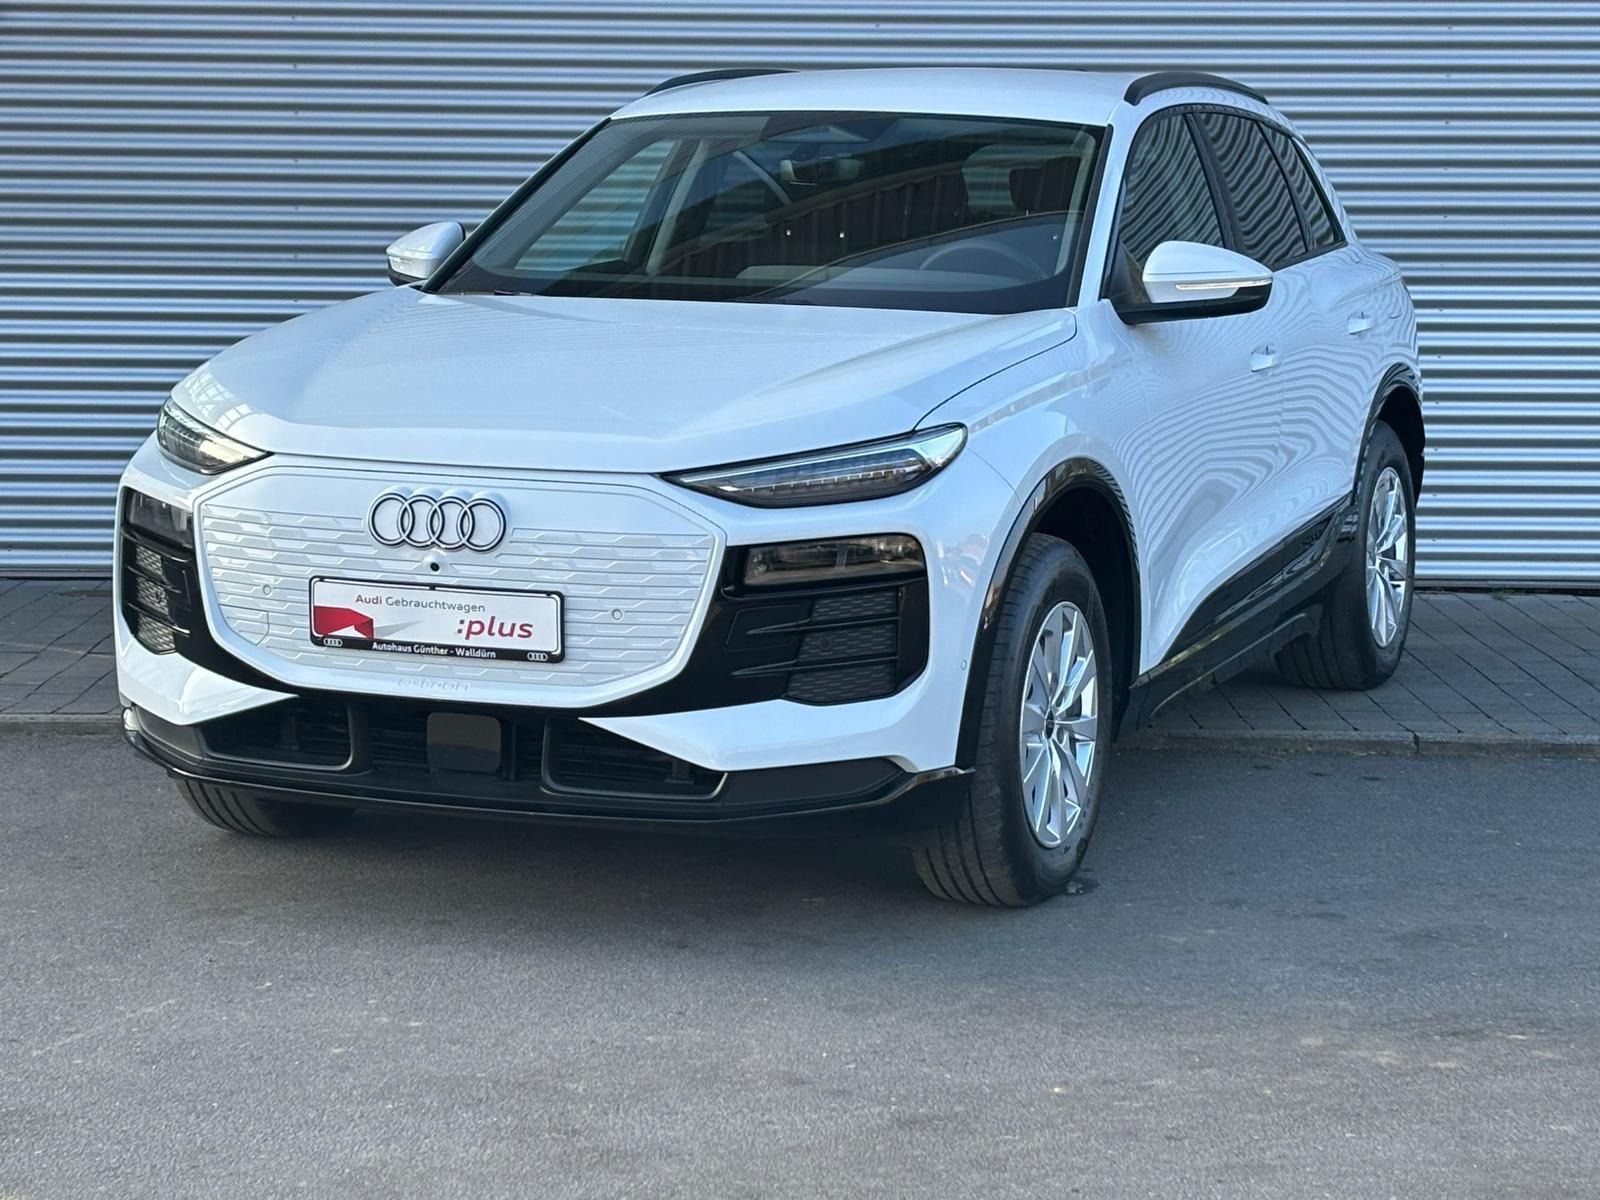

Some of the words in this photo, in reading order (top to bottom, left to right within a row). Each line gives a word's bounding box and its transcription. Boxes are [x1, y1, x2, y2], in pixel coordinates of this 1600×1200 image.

[355, 594, 382, 605] Audi
[385, 595, 486, 614] Gebrauchtwagen
[456, 616, 534, 640] :plus
[372, 642, 412, 652] Autohaus
[413, 644, 448, 655] Günther
[455, 647, 496, 658] Walldürn
